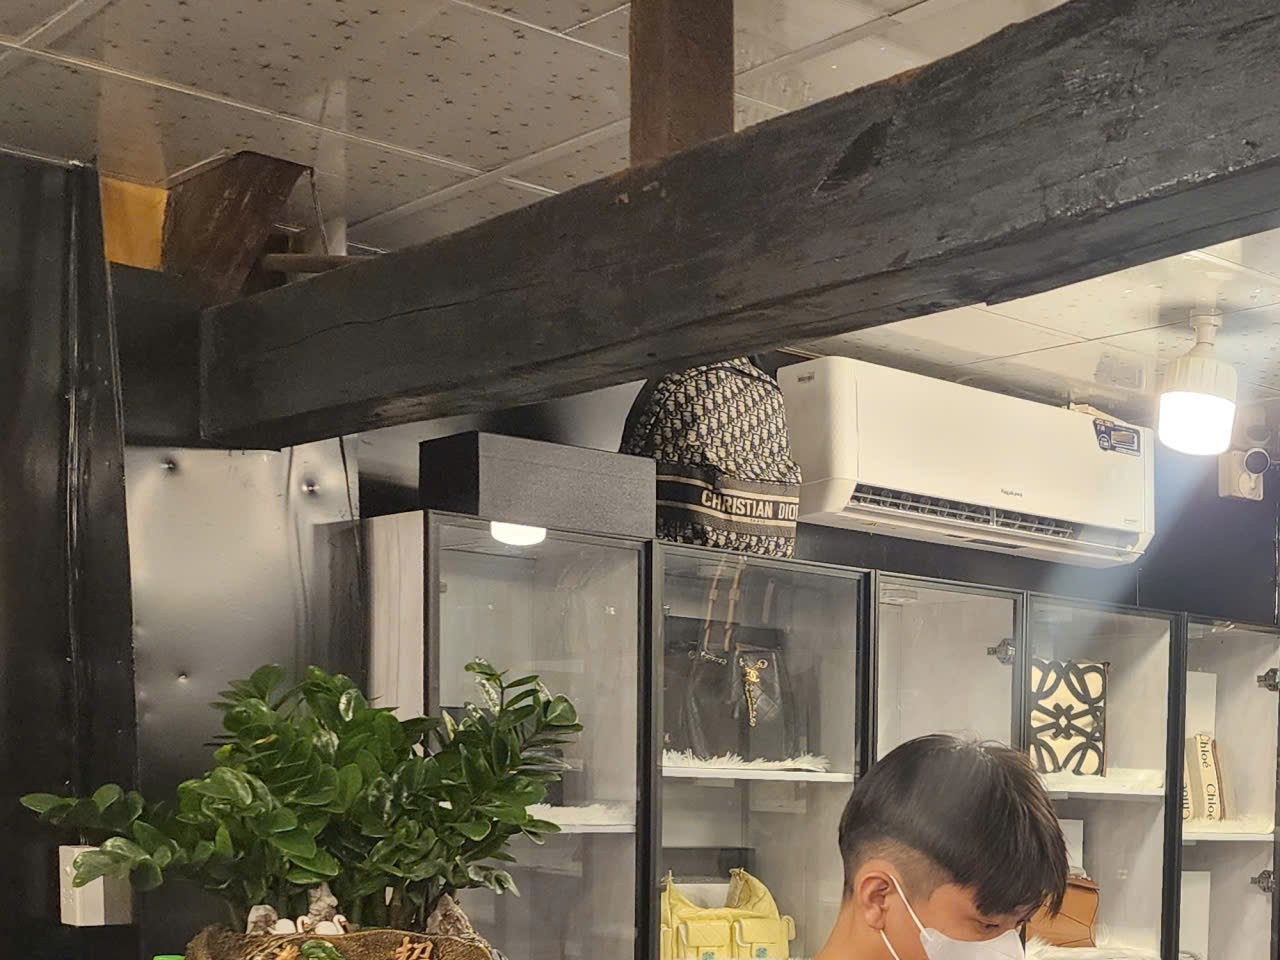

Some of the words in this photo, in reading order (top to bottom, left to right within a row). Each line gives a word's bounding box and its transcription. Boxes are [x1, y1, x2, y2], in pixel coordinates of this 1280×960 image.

[702, 490, 773, 518] CHRISTIAN
[1200, 734, 1211, 768] Chloé
[1206, 783, 1217, 820] Chloé
